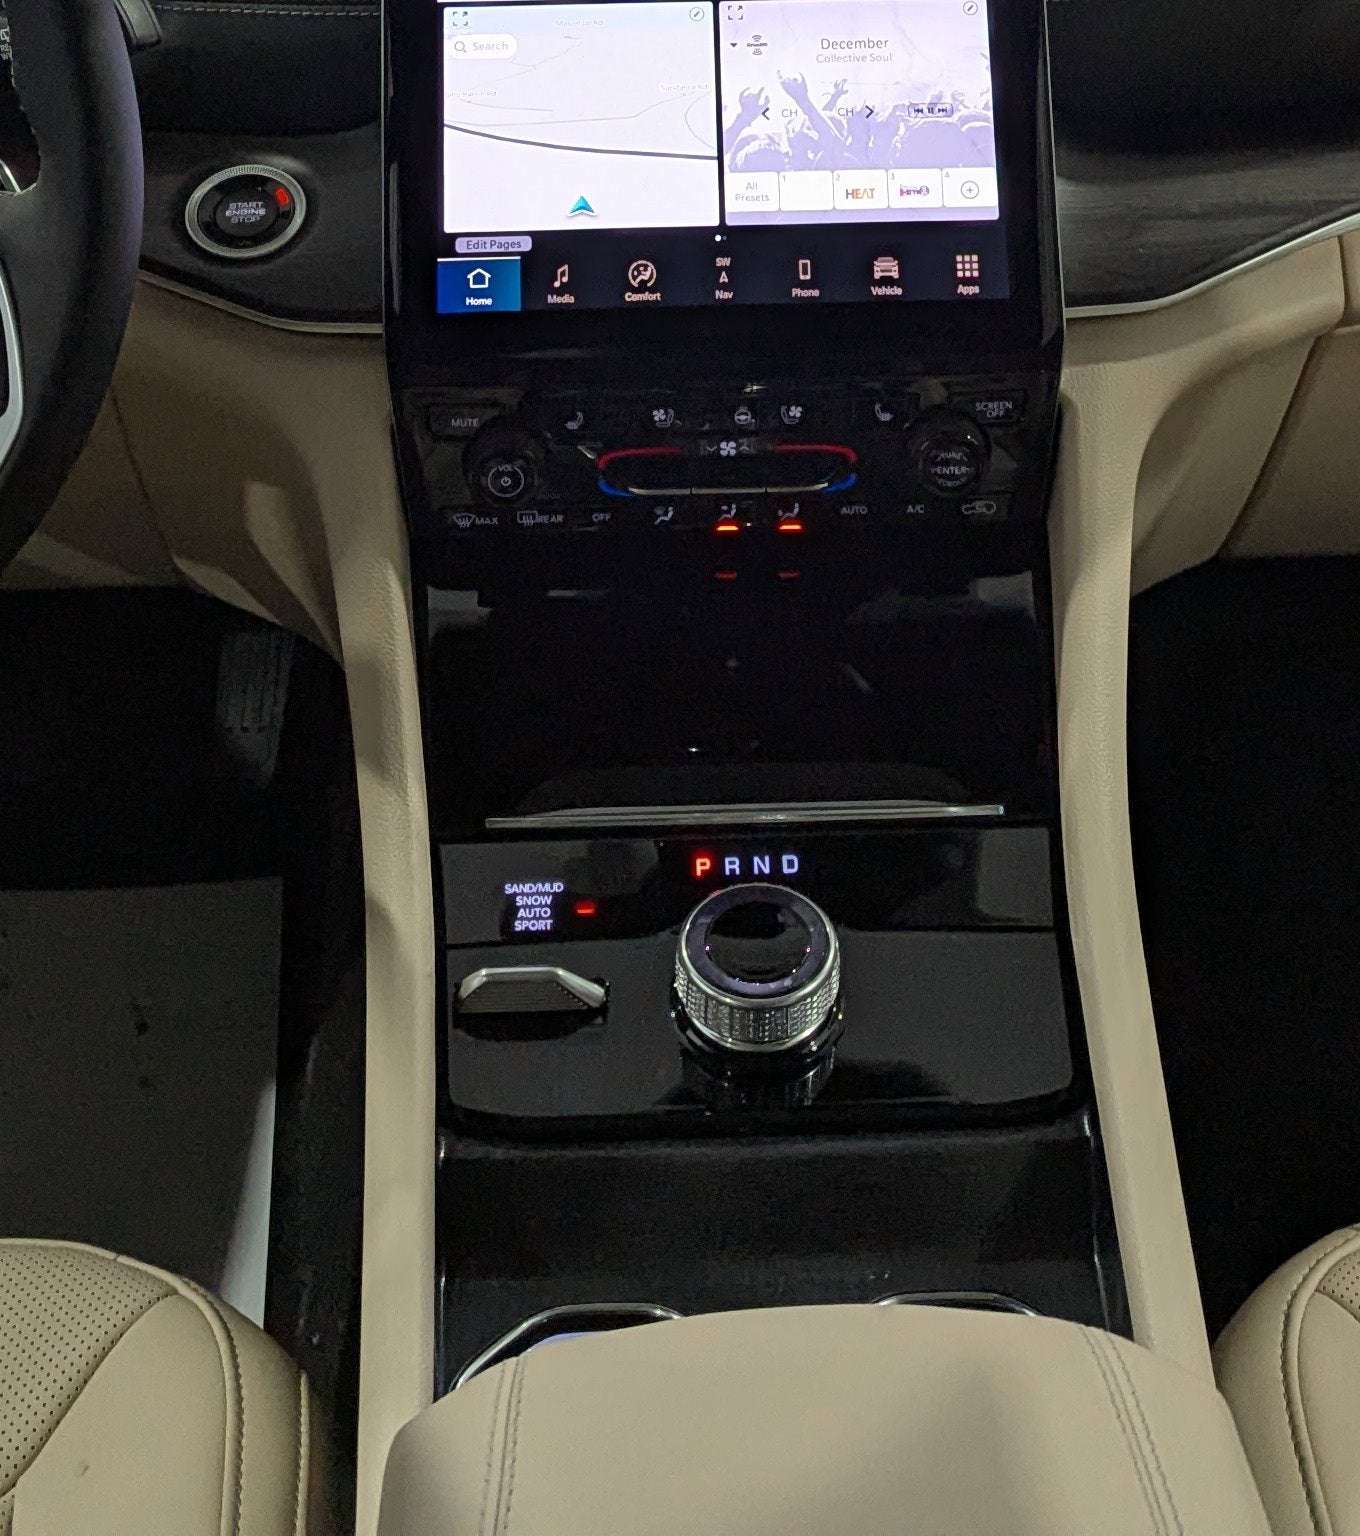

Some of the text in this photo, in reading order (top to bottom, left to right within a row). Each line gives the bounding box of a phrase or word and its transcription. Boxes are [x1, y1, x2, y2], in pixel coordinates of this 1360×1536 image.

[472, 40, 508, 52] Search
[820, 38, 889, 50] December
[816, 52, 892, 63] Collective Soul
[781, 108, 798, 117] CH
[837, 107, 855, 117] CH
[735, 193, 770, 203] Presets
[845, 188, 875, 199] HEAT
[229, 201, 263, 210] START
[225, 208, 266, 217] ENGINE
[466, 239, 522, 252] Edit Pages
[715, 289, 733, 300] Nav
[792, 288, 820, 298] Phone
[871, 286, 902, 296] Vehicle
[957, 284, 979, 296] Apps
[465, 296, 492, 306] Home
[547, 294, 575, 304] Media
[625, 291, 661, 302] Comfort
[451, 418, 480, 427] MUTE
[937, 466, 967, 475] ENTER
[840, 505, 868, 514] AUTO
[907, 504, 925, 513] A/C
[475, 516, 499, 525] MAX
[592, 513, 611, 522] OFF
[695, 854, 799, 877] P R N D
[504, 882, 565, 894] SAND/MUD
[515, 894, 553, 906] SNOW
[517, 907, 551, 918] AUTO
[513, 919, 553, 931] SPORT
